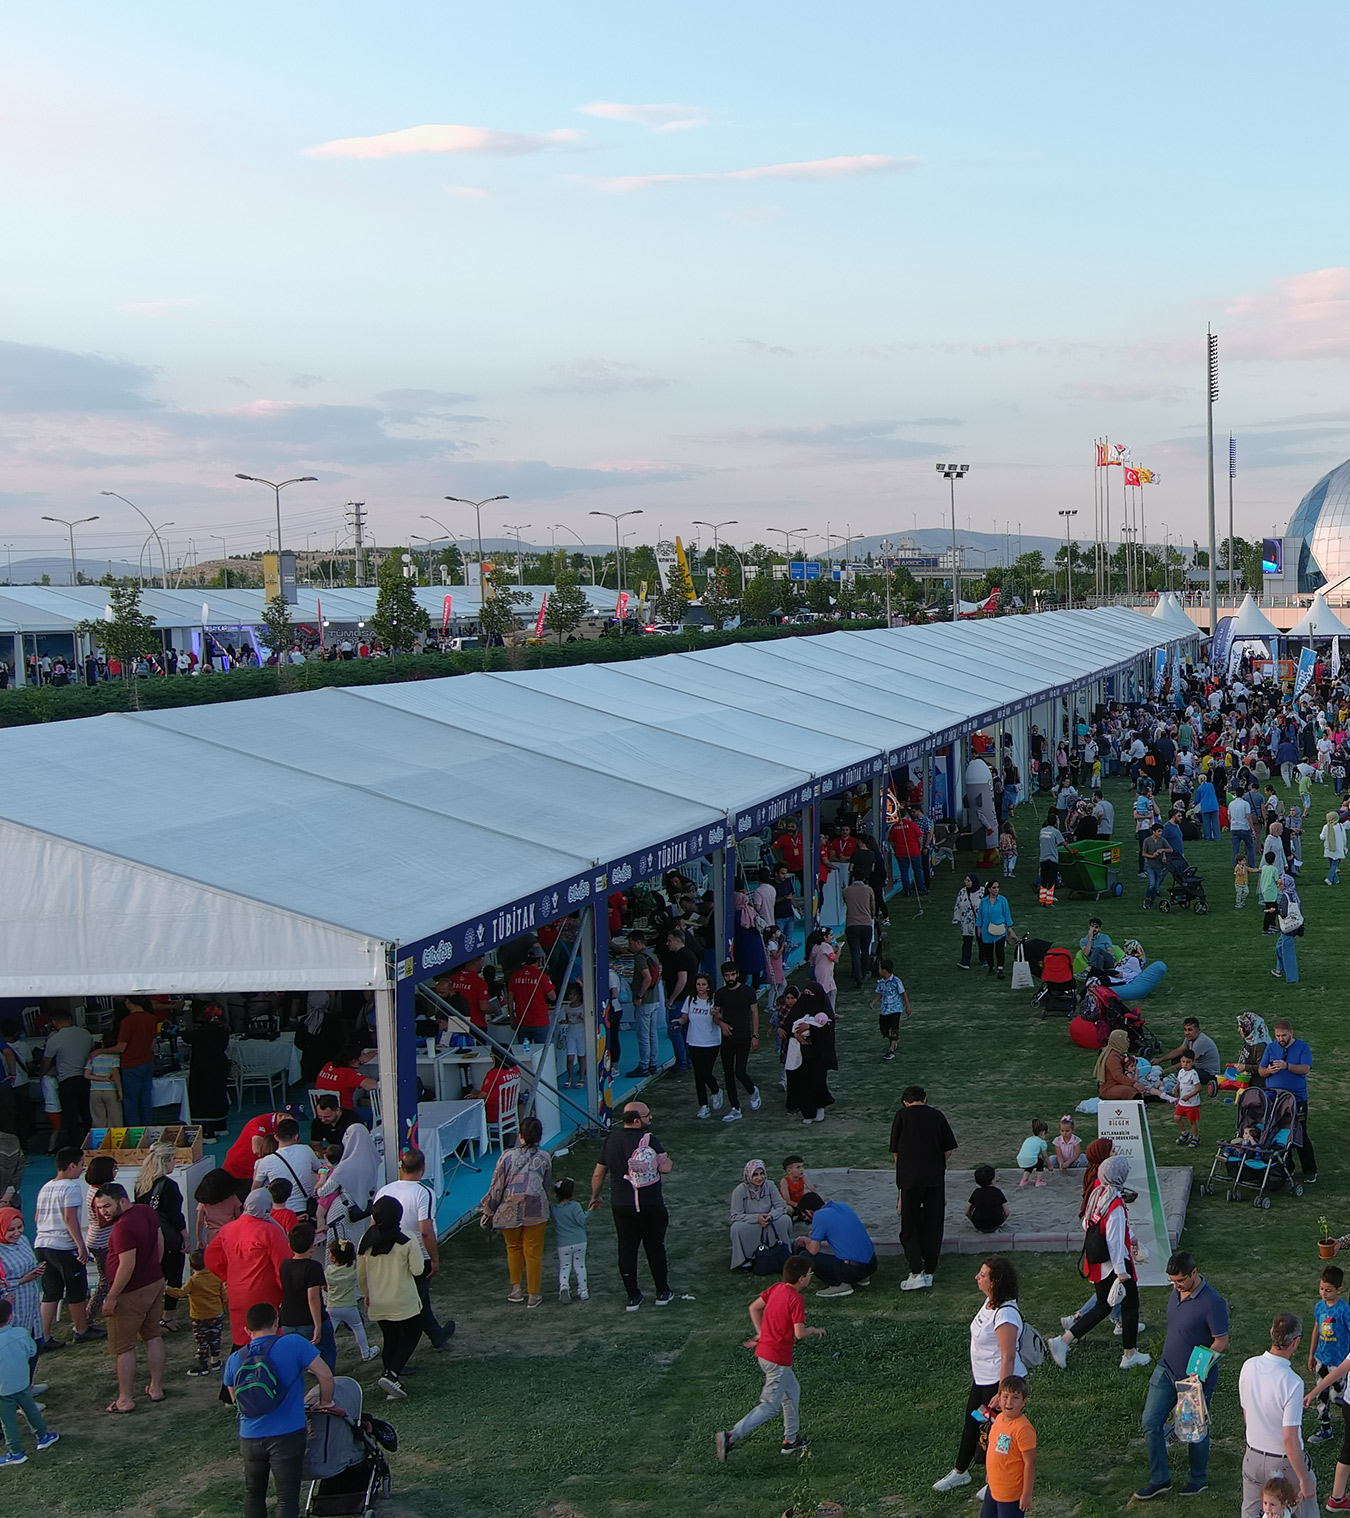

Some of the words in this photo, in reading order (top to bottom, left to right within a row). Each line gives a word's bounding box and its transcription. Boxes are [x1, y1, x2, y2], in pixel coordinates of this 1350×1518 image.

[328, 629, 377, 637] TÜMOSA
[768, 798, 787, 822] TÜBİTAK
[658, 840, 687, 870] TÜBİTAK
[492, 902, 535, 943] TÜBİTAK
